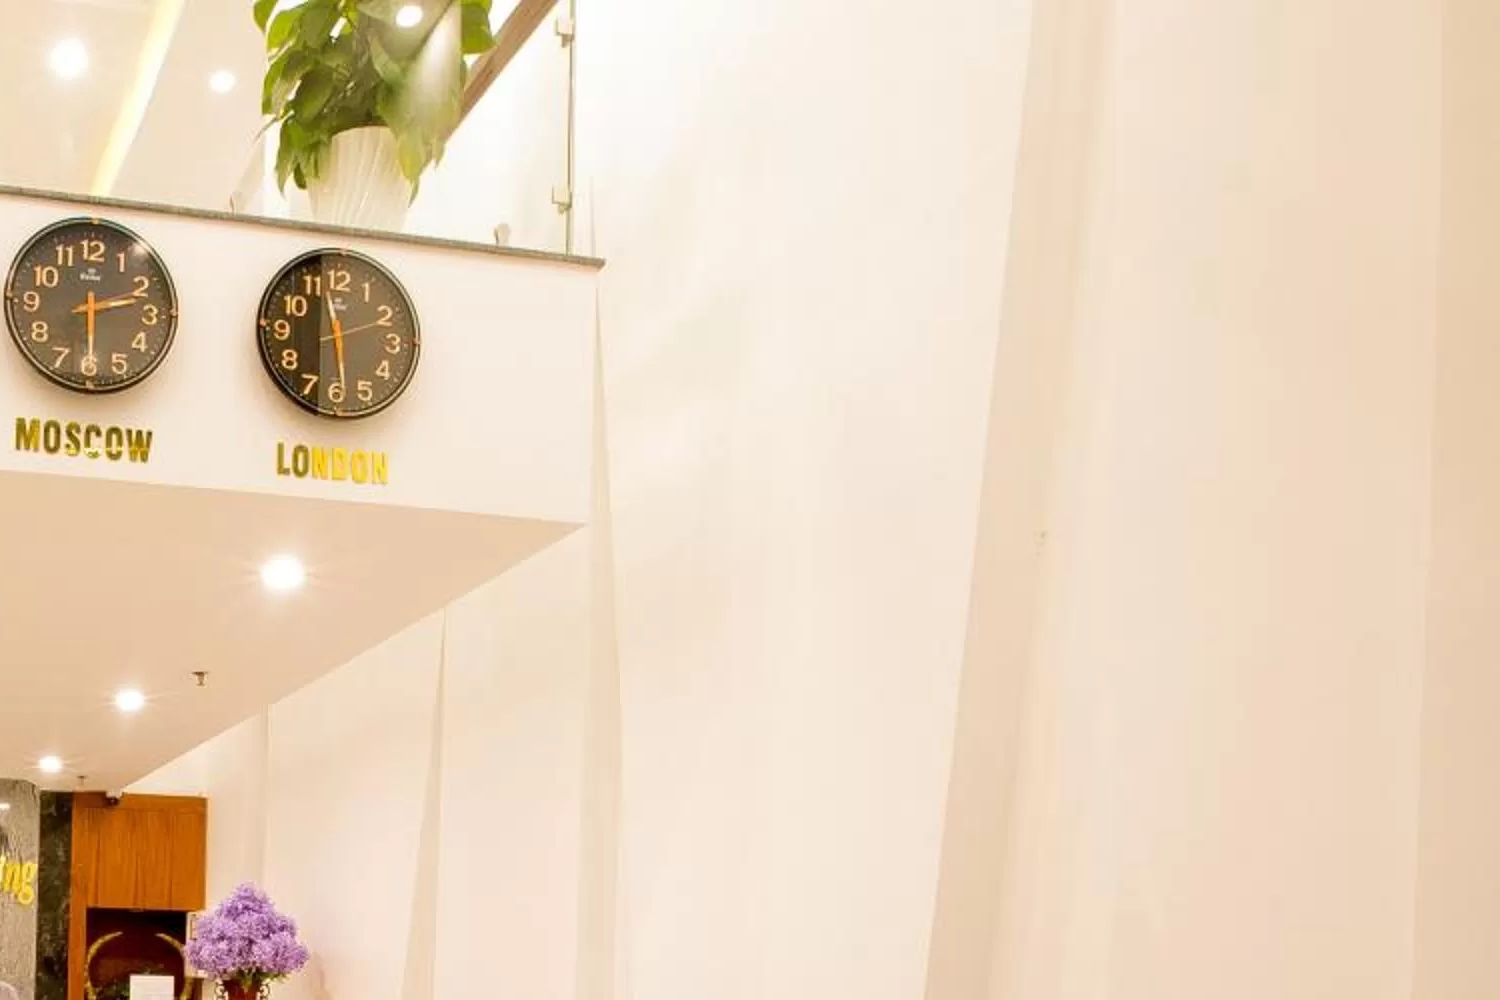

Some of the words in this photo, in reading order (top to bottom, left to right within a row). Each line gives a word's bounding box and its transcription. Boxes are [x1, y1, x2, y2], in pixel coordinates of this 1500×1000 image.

[55, 244, 74, 267] 11
[80, 239, 106, 262] 12
[115, 252, 125, 273] 1
[33, 265, 59, 288] 10
[132, 275, 149, 298] 2
[302, 274, 321, 296] 11
[326, 269, 351, 292] 12
[23, 291, 40, 312] 9
[361, 282, 371, 303] 1
[141, 304, 158, 326] 3
[284, 295, 307, 317] 10
[376, 305, 393, 327] 2
[31, 321, 48, 343] 8
[273, 319, 291, 341] 9
[131, 332, 148, 353] 4
[385, 333, 401, 354] 3
[52, 347, 70, 368] 7
[81, 355, 97, 376] 6
[111, 352, 128, 375] 5
[281, 349, 298, 370] 8
[375, 360, 390, 381] 4
[301, 374, 319, 395] 7
[327, 382, 346, 403] 6
[357, 379, 373, 401] 5
[15, 416, 153, 464] MOSCOW
[276, 442, 389, 485] LONDON
